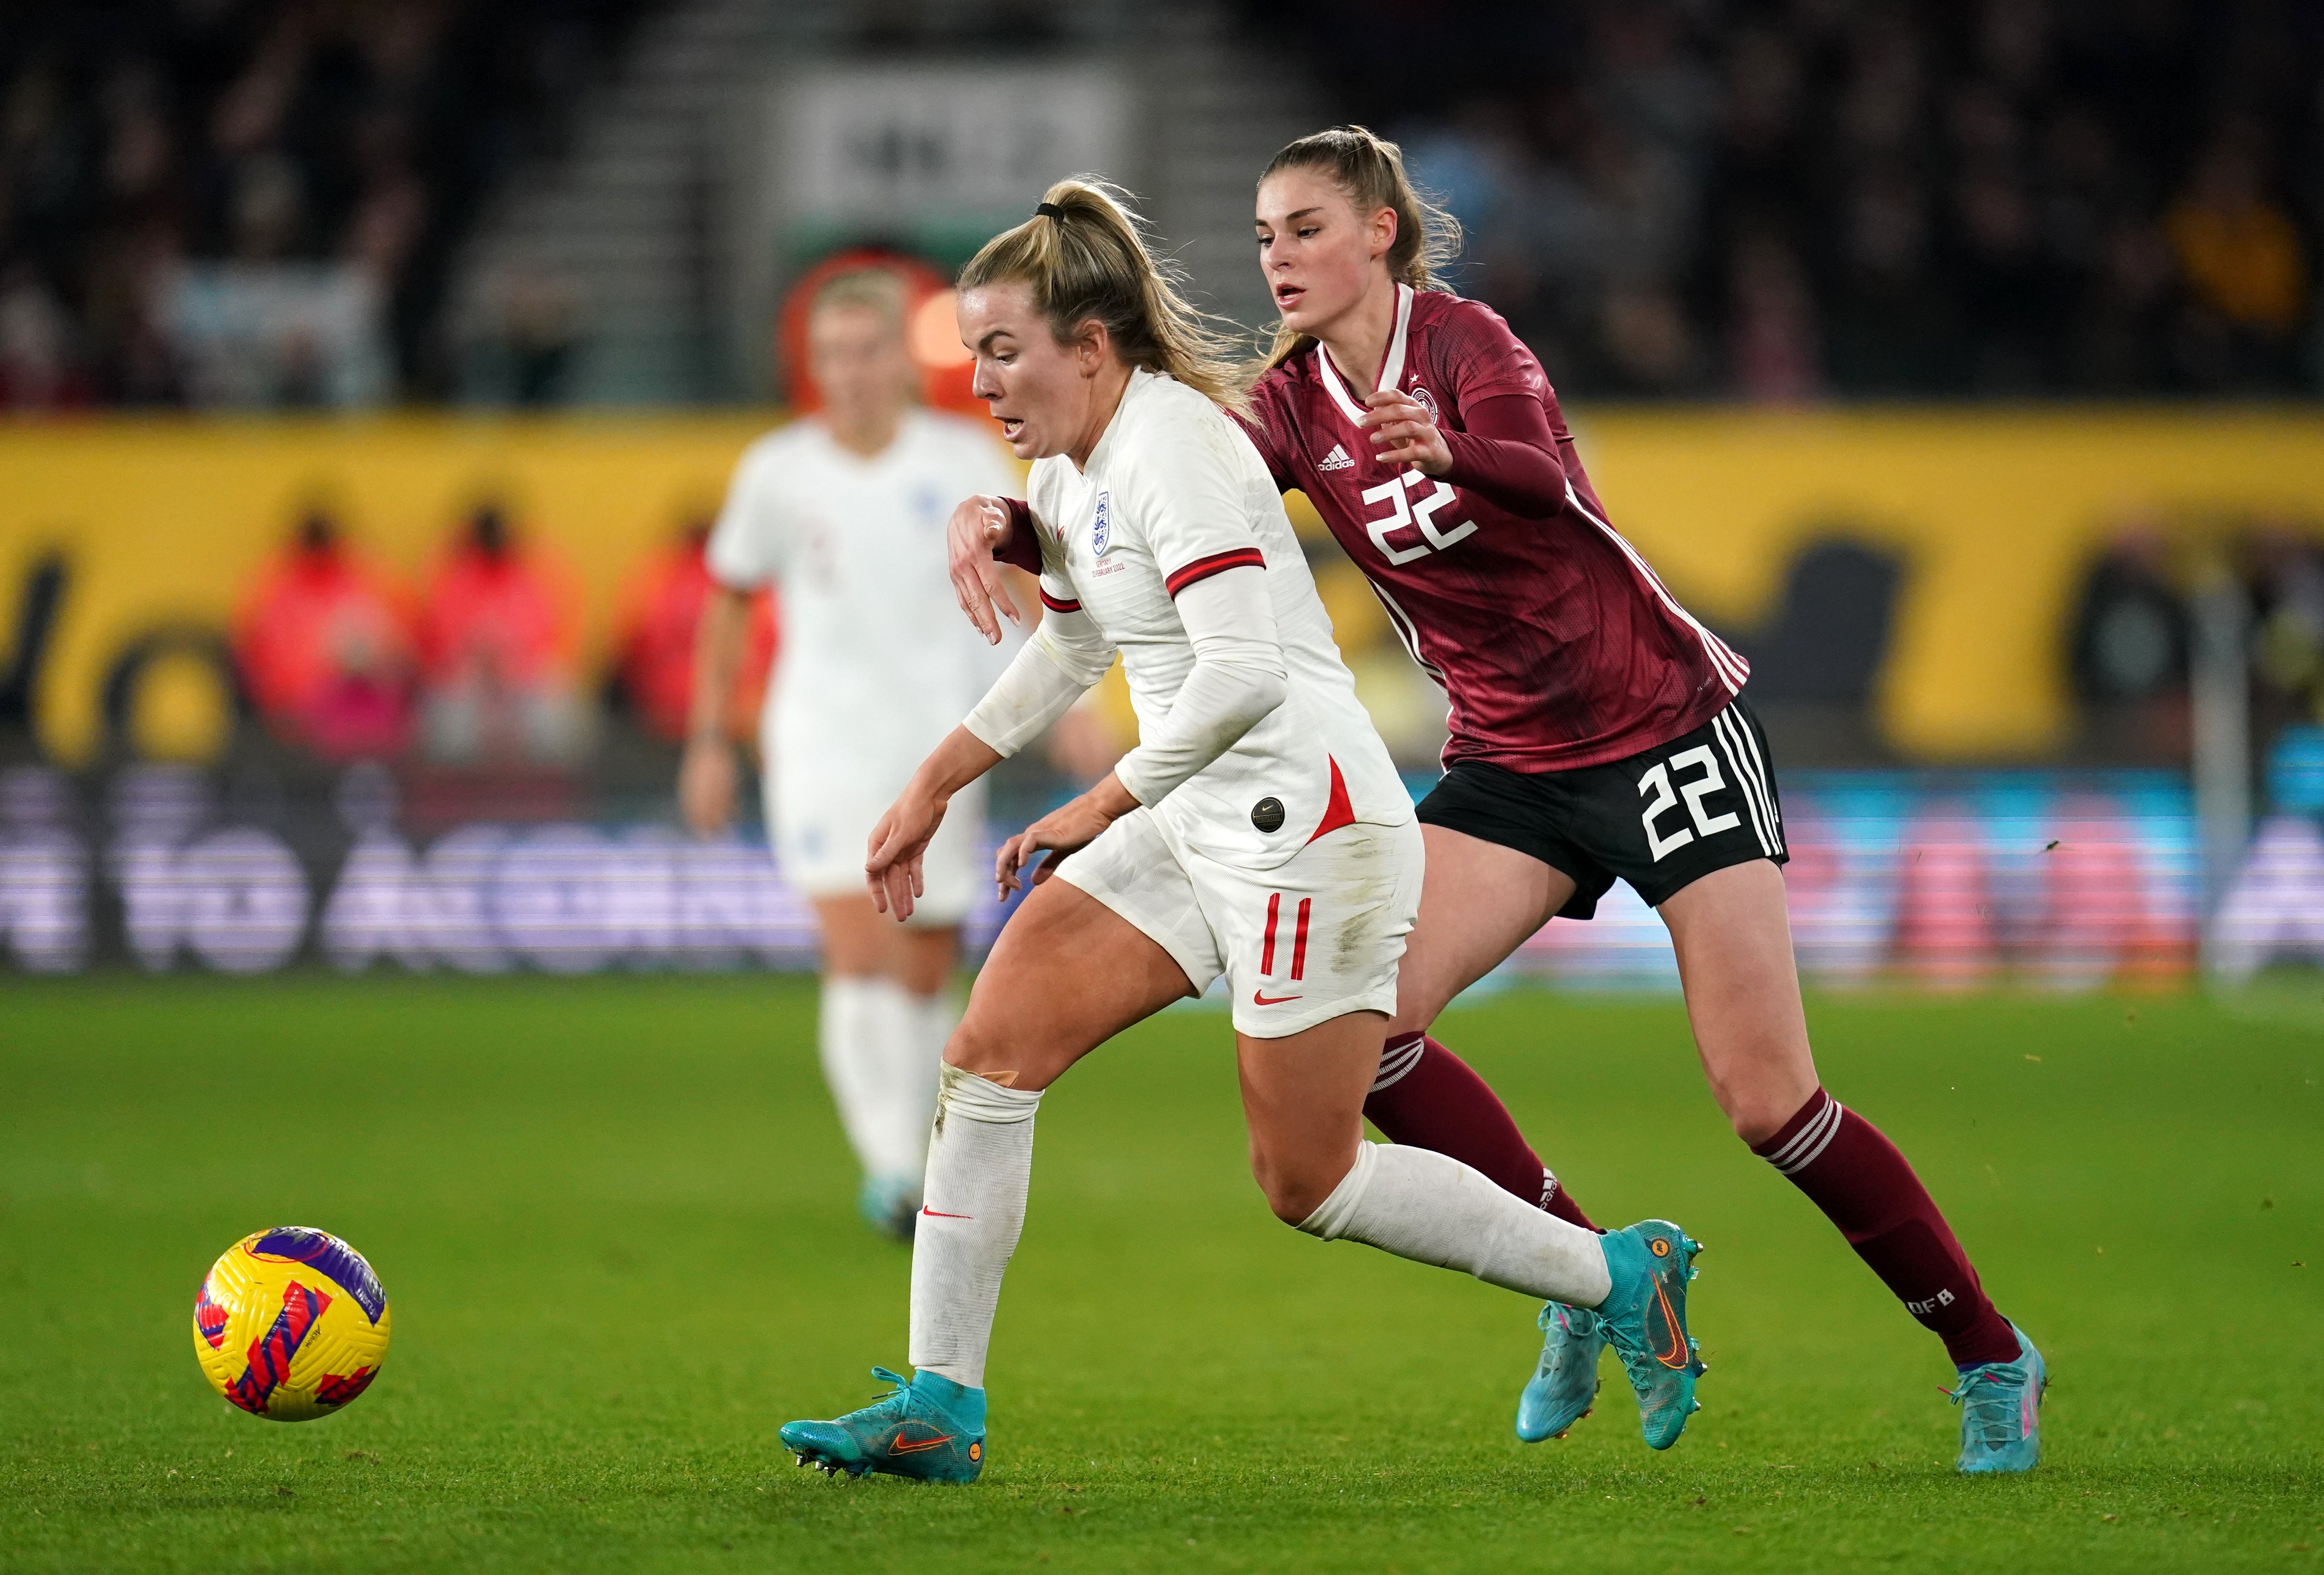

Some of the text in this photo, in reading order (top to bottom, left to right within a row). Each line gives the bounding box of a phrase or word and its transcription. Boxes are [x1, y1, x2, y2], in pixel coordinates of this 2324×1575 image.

[1318, 459, 1355, 471] adidas
[1361, 469, 1479, 566] 22
[1095, 557, 1112, 568] GERMANY
[1095, 566, 1113, 577] FEBRUARY
[1112, 562, 1126, 573] 2022
[1637, 744, 1741, 863] 22
[1260, 892, 1311, 981] 11
[1907, 1288, 1956, 1314] DFB
